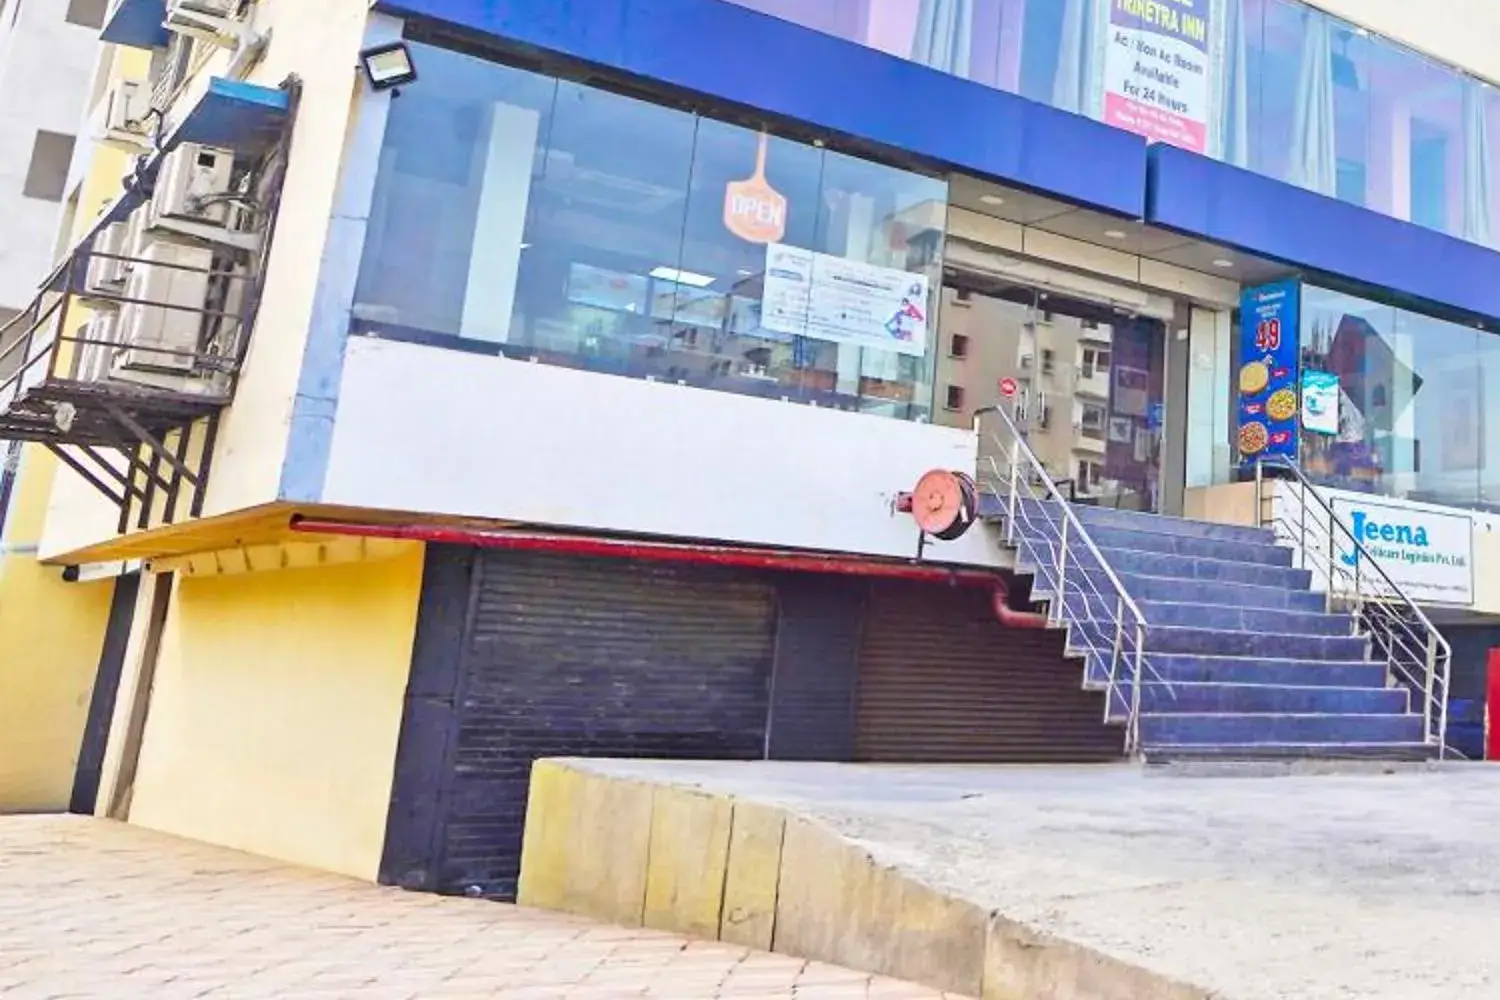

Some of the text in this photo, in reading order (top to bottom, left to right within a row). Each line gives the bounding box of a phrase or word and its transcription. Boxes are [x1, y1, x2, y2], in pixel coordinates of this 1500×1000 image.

[1181, 12, 1206, 43] INN
[1123, 79, 1140, 97] For
[1142, 87, 1156, 102] 24
[732, 196, 782, 226] OPEN
[1256, 318, 1280, 351] 49
[1340, 511, 1429, 567] Jeena
